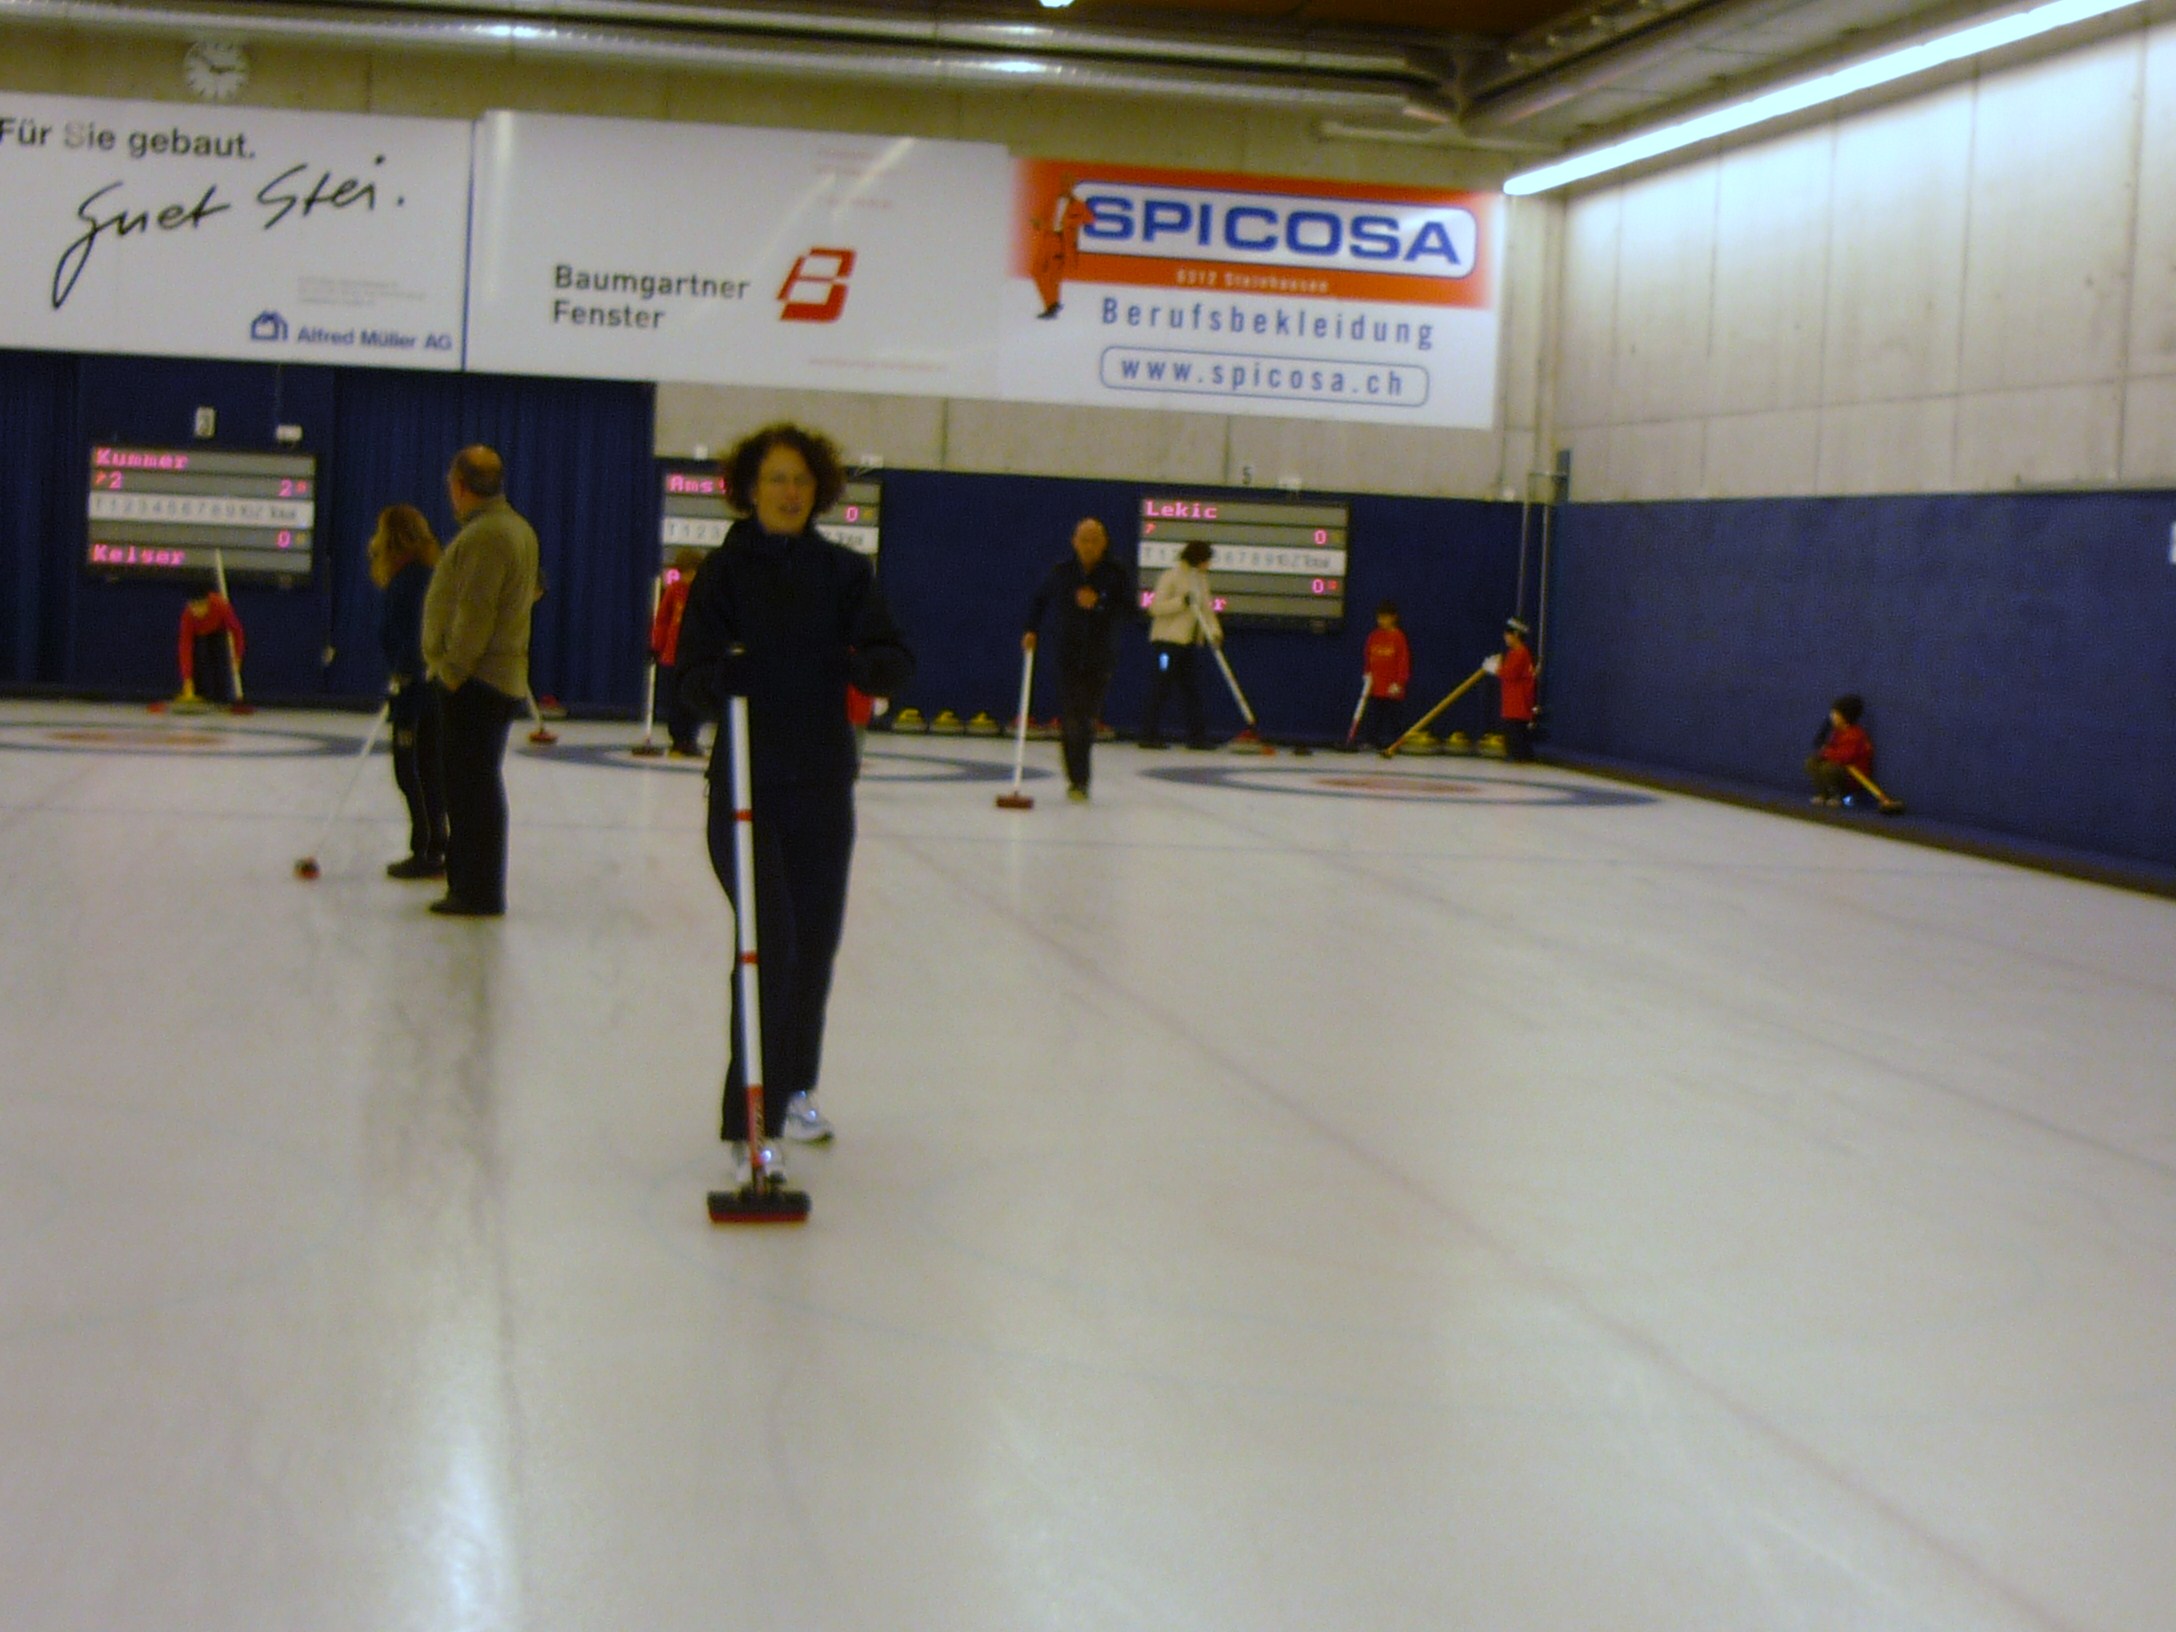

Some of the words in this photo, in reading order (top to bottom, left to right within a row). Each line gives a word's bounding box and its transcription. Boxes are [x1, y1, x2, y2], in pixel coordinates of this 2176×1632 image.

[0, 117, 51, 148] Für
[63, 121, 116, 152] Sie
[128, 128, 256, 159] gebaut.
[1082, 195, 1461, 266] SPICOSA
[553, 264, 751, 300] Baumgartner
[552, 300, 665, 329] Fenster
[1102, 297, 1435, 350] Berufsbekleidung
[298, 325, 355, 346] Alfred
[360, 328, 416, 348] Müller
[424, 333, 452, 350] AG
[1122, 356, 1403, 398] www.spicosa.ch
[96, 448, 188, 471] Kummer
[109, 470, 122, 490] 2
[278, 479, 292, 497] 2
[845, 505, 859, 522] 0
[1145, 500, 1218, 519] Lekic
[277, 530, 291, 548] 0
[1313, 529, 1327, 545] 0
[1312, 578, 1325, 594] 0
